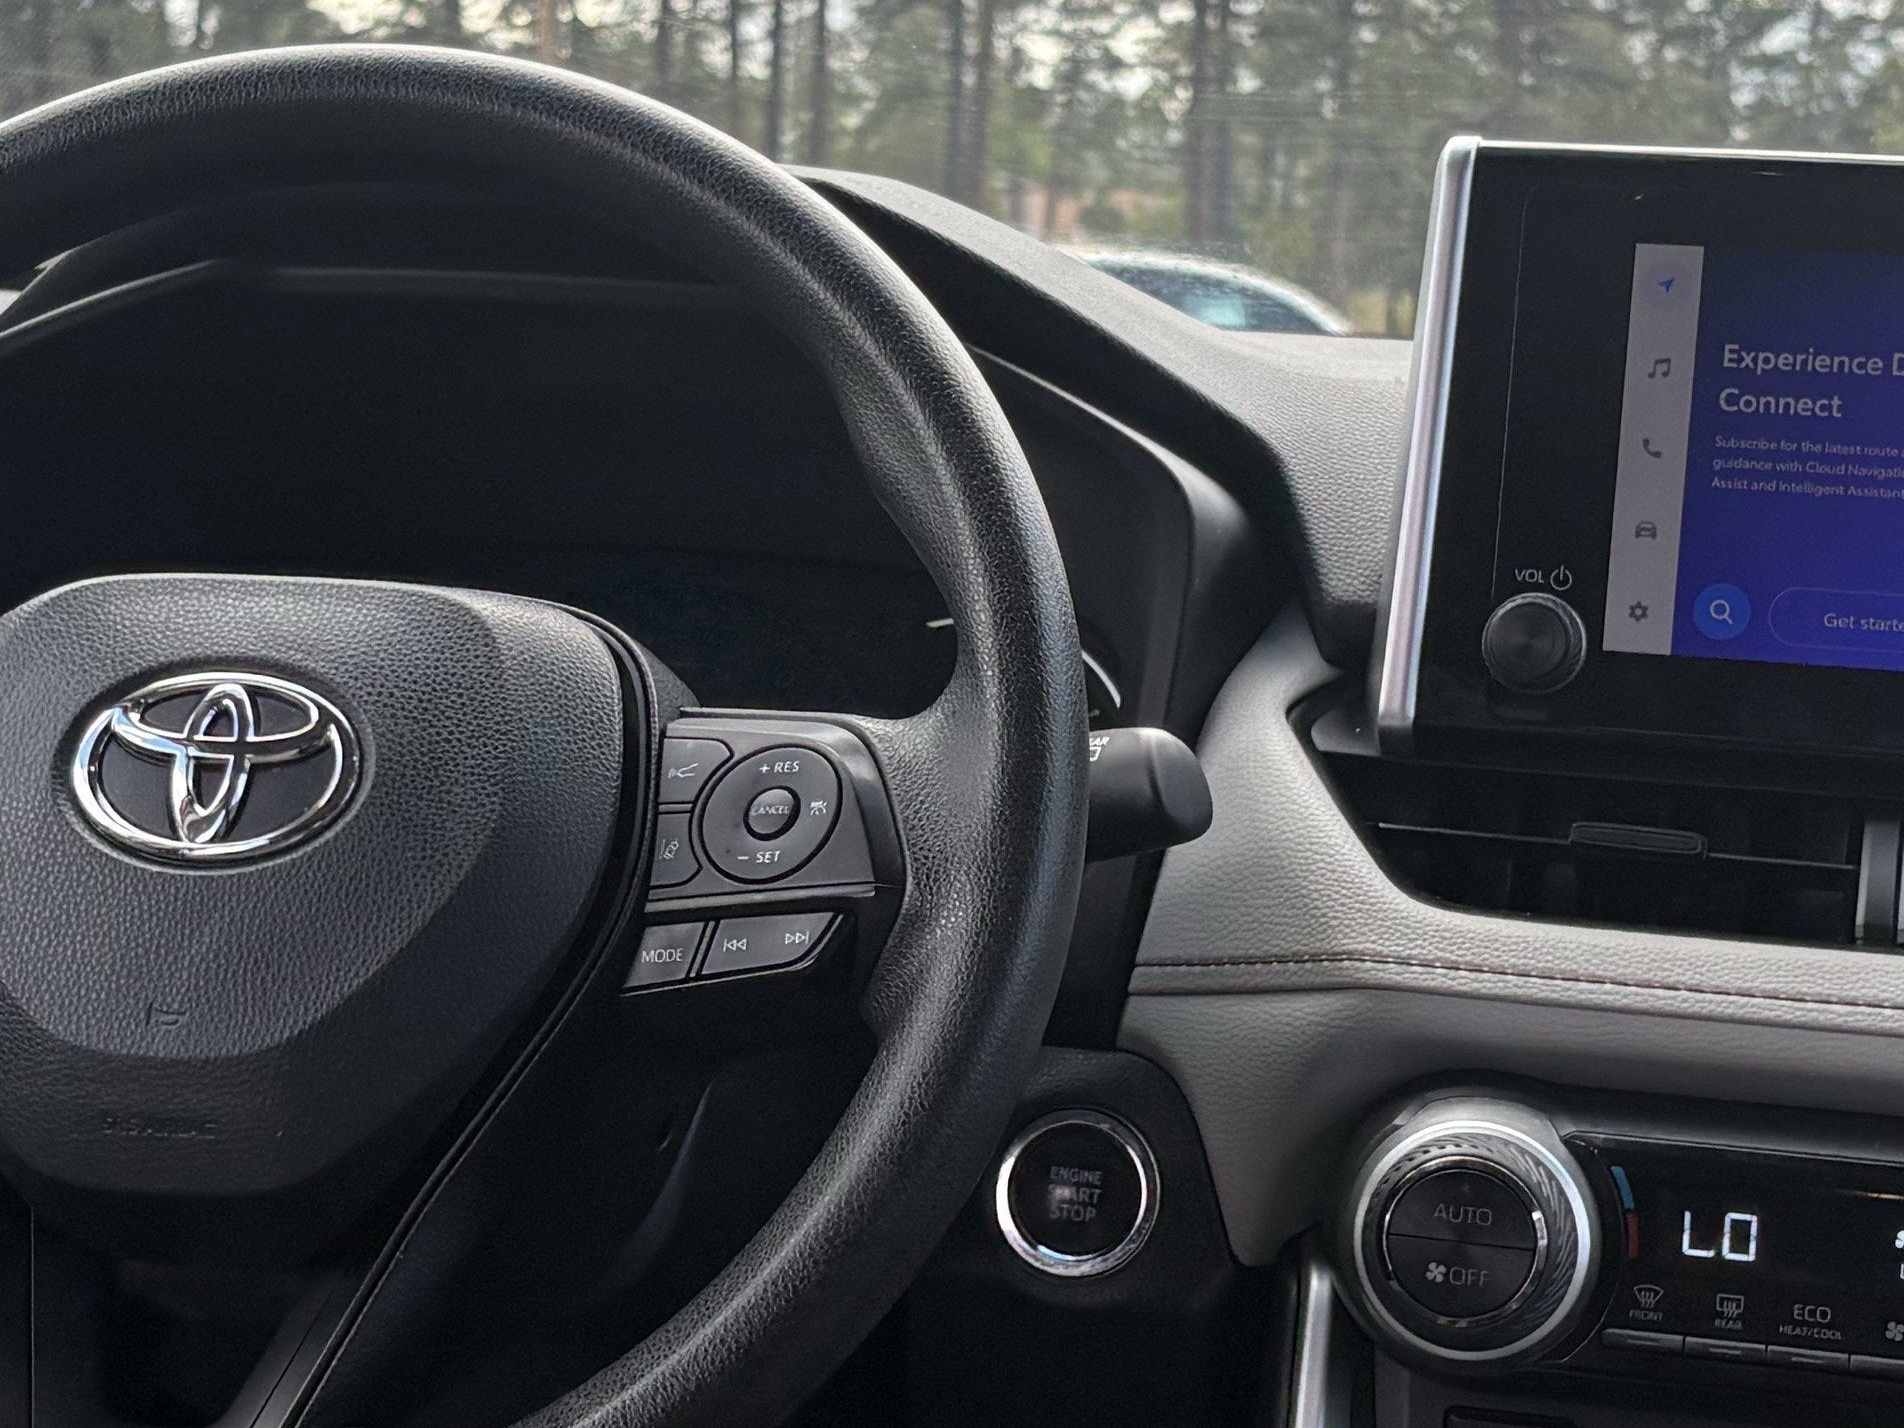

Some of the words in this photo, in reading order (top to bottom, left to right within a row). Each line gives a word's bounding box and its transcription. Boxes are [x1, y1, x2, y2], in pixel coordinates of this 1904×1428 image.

[1723, 344, 1883, 375] Experience
[1719, 388, 1843, 418] Connect
[1715, 435, 1777, 450] Subscribe
[1780, 440, 1798, 451] for
[1801, 441, 1822, 453] the
[1825, 442, 1862, 456] latest
[1864, 446, 1899, 458] route
[1712, 458, 1773, 472] guidance
[1776, 461, 1803, 473] with
[1805, 462, 1845, 476] Cloud
[1711, 476, 1748, 491] Assist
[1750, 479, 1776, 492] and
[1779, 481, 1844, 497] Intelligent
[1514, 568, 1545, 584] VOL
[1823, 613, 1854, 631] Get
[773, 760, 800, 773] RES
[750, 803, 791, 816] CANCEL
[755, 851, 781, 864] SET
[641, 947, 684, 963] MODE
[1049, 1165, 1102, 1185] ENGINE
[1049, 1203, 1097, 1222] STOP
[1433, 1203, 1494, 1227] AUTO
[1681, 1210, 1759, 1263] LO
[1449, 1266, 1490, 1287] OFF
[1629, 1310, 1664, 1322] FRONT
[1793, 1303, 1832, 1324] ECO
[1714, 1319, 1744, 1331] REAR
